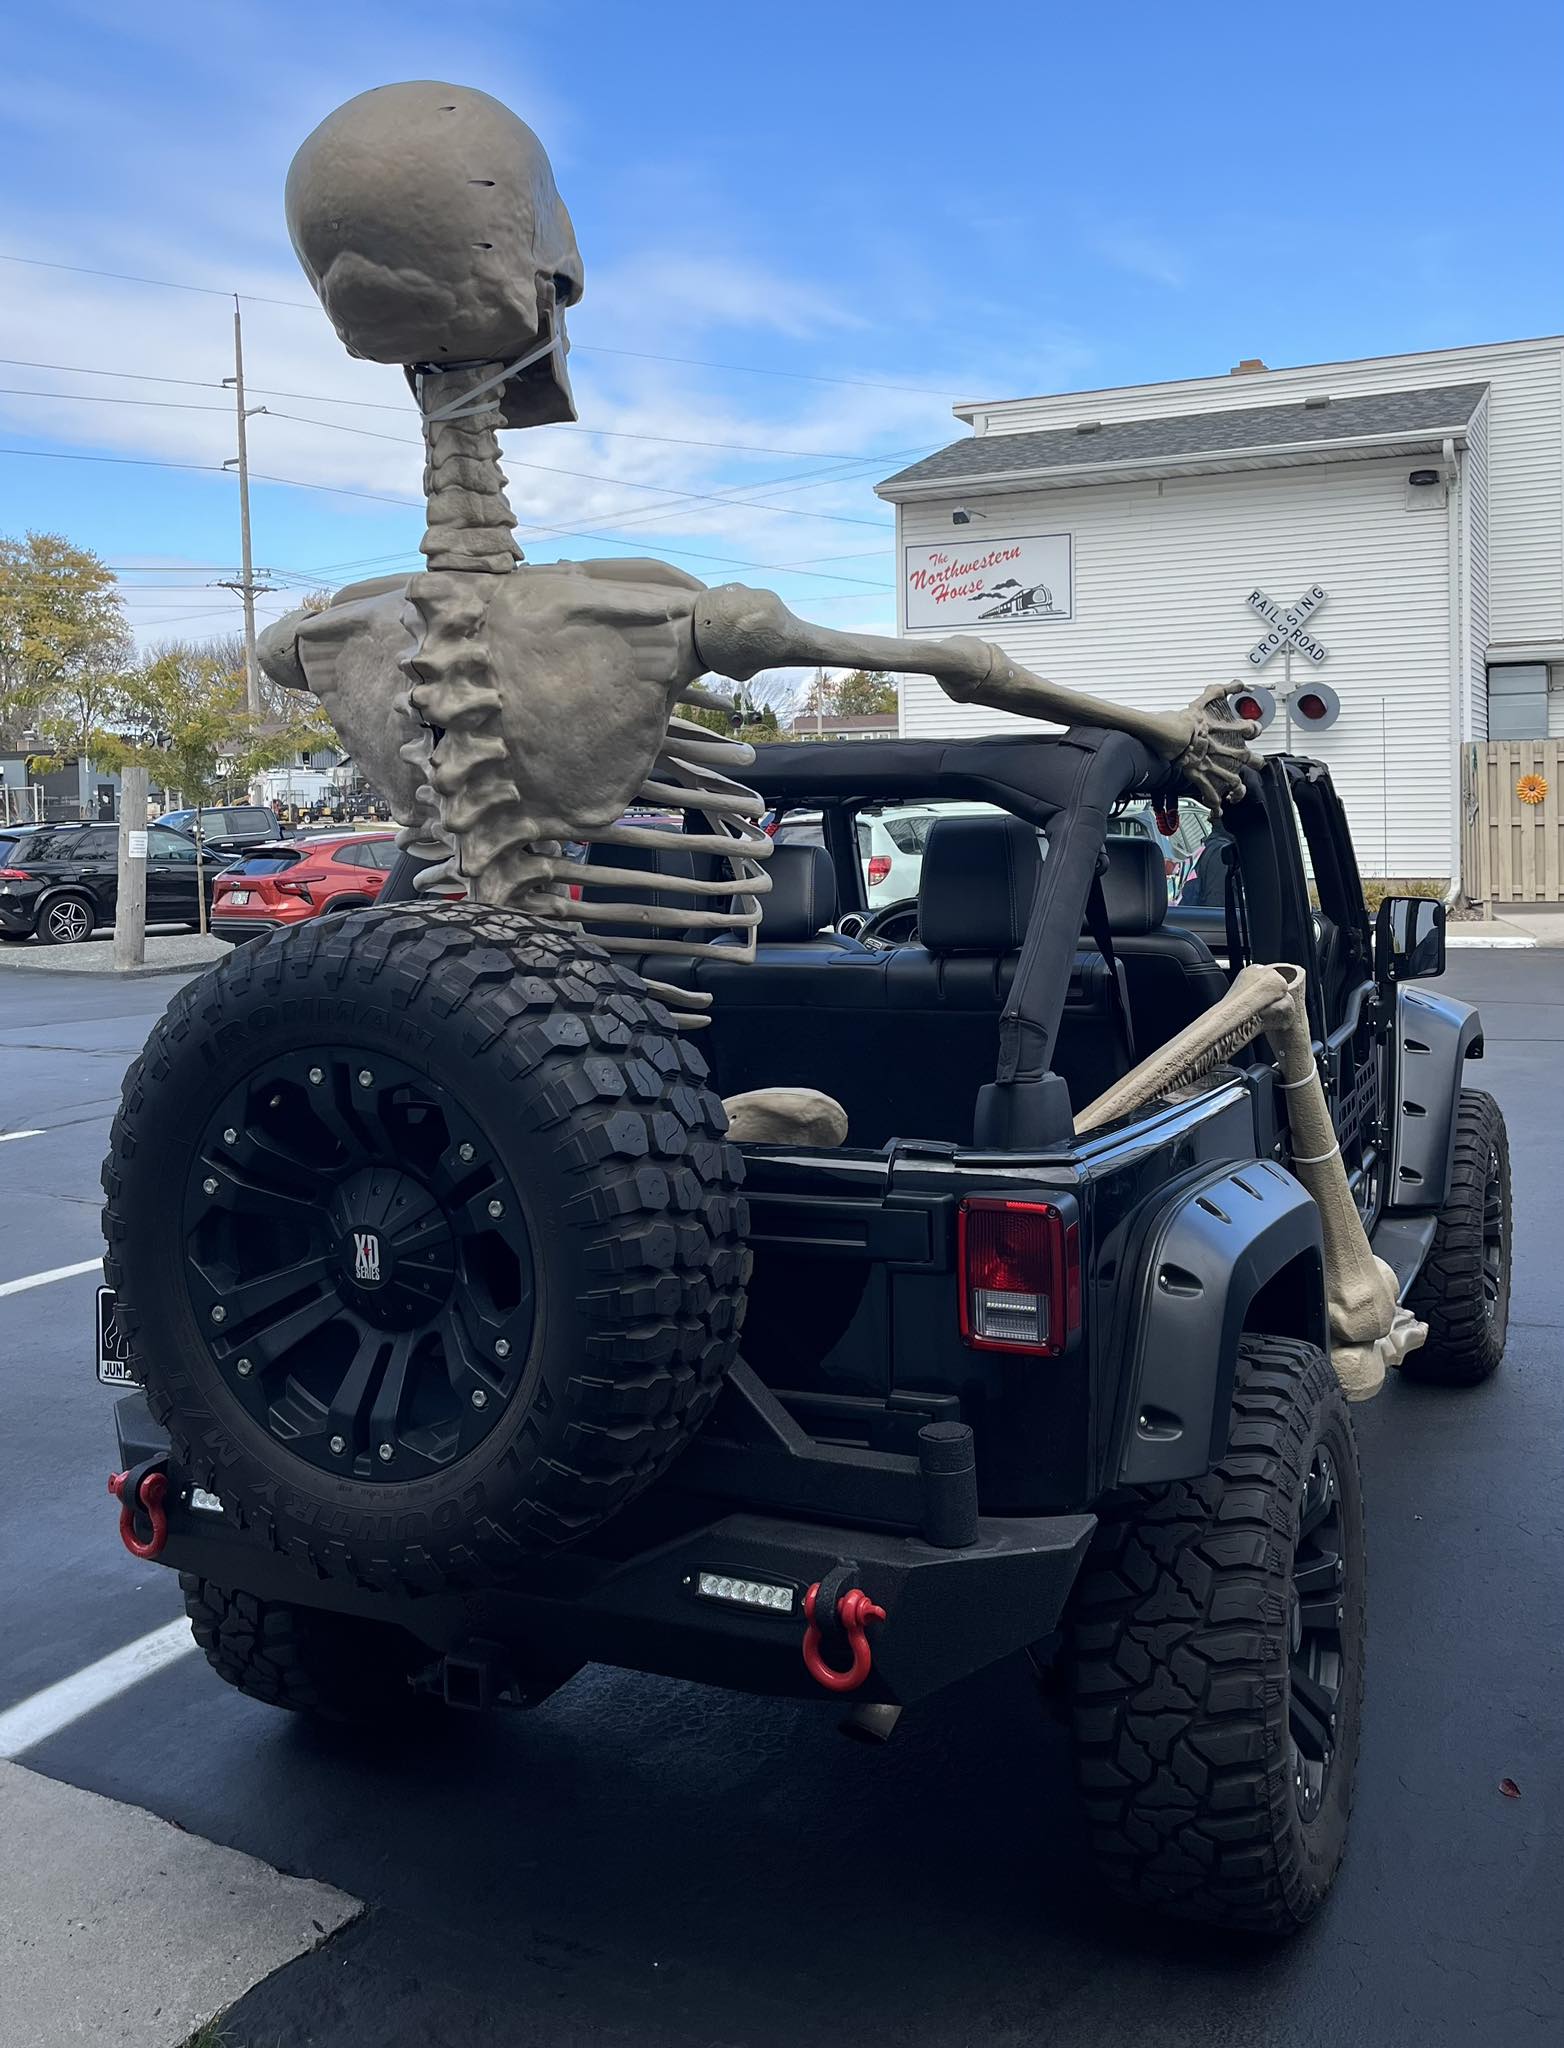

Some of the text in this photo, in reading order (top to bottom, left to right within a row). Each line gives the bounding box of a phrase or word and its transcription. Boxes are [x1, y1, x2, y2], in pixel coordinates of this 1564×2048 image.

[909, 546, 1022, 590] Northwestern
[929, 553, 949, 567] The
[931, 579, 985, 605] House
[1248, 591, 1325, 661] RAIL ROAD
[1249, 587, 1324, 664] CROSSING
[353, 1233, 379, 1268] XD
[355, 1265, 380, 1280] SERIES
[104, 1362, 123, 1377] JUN
